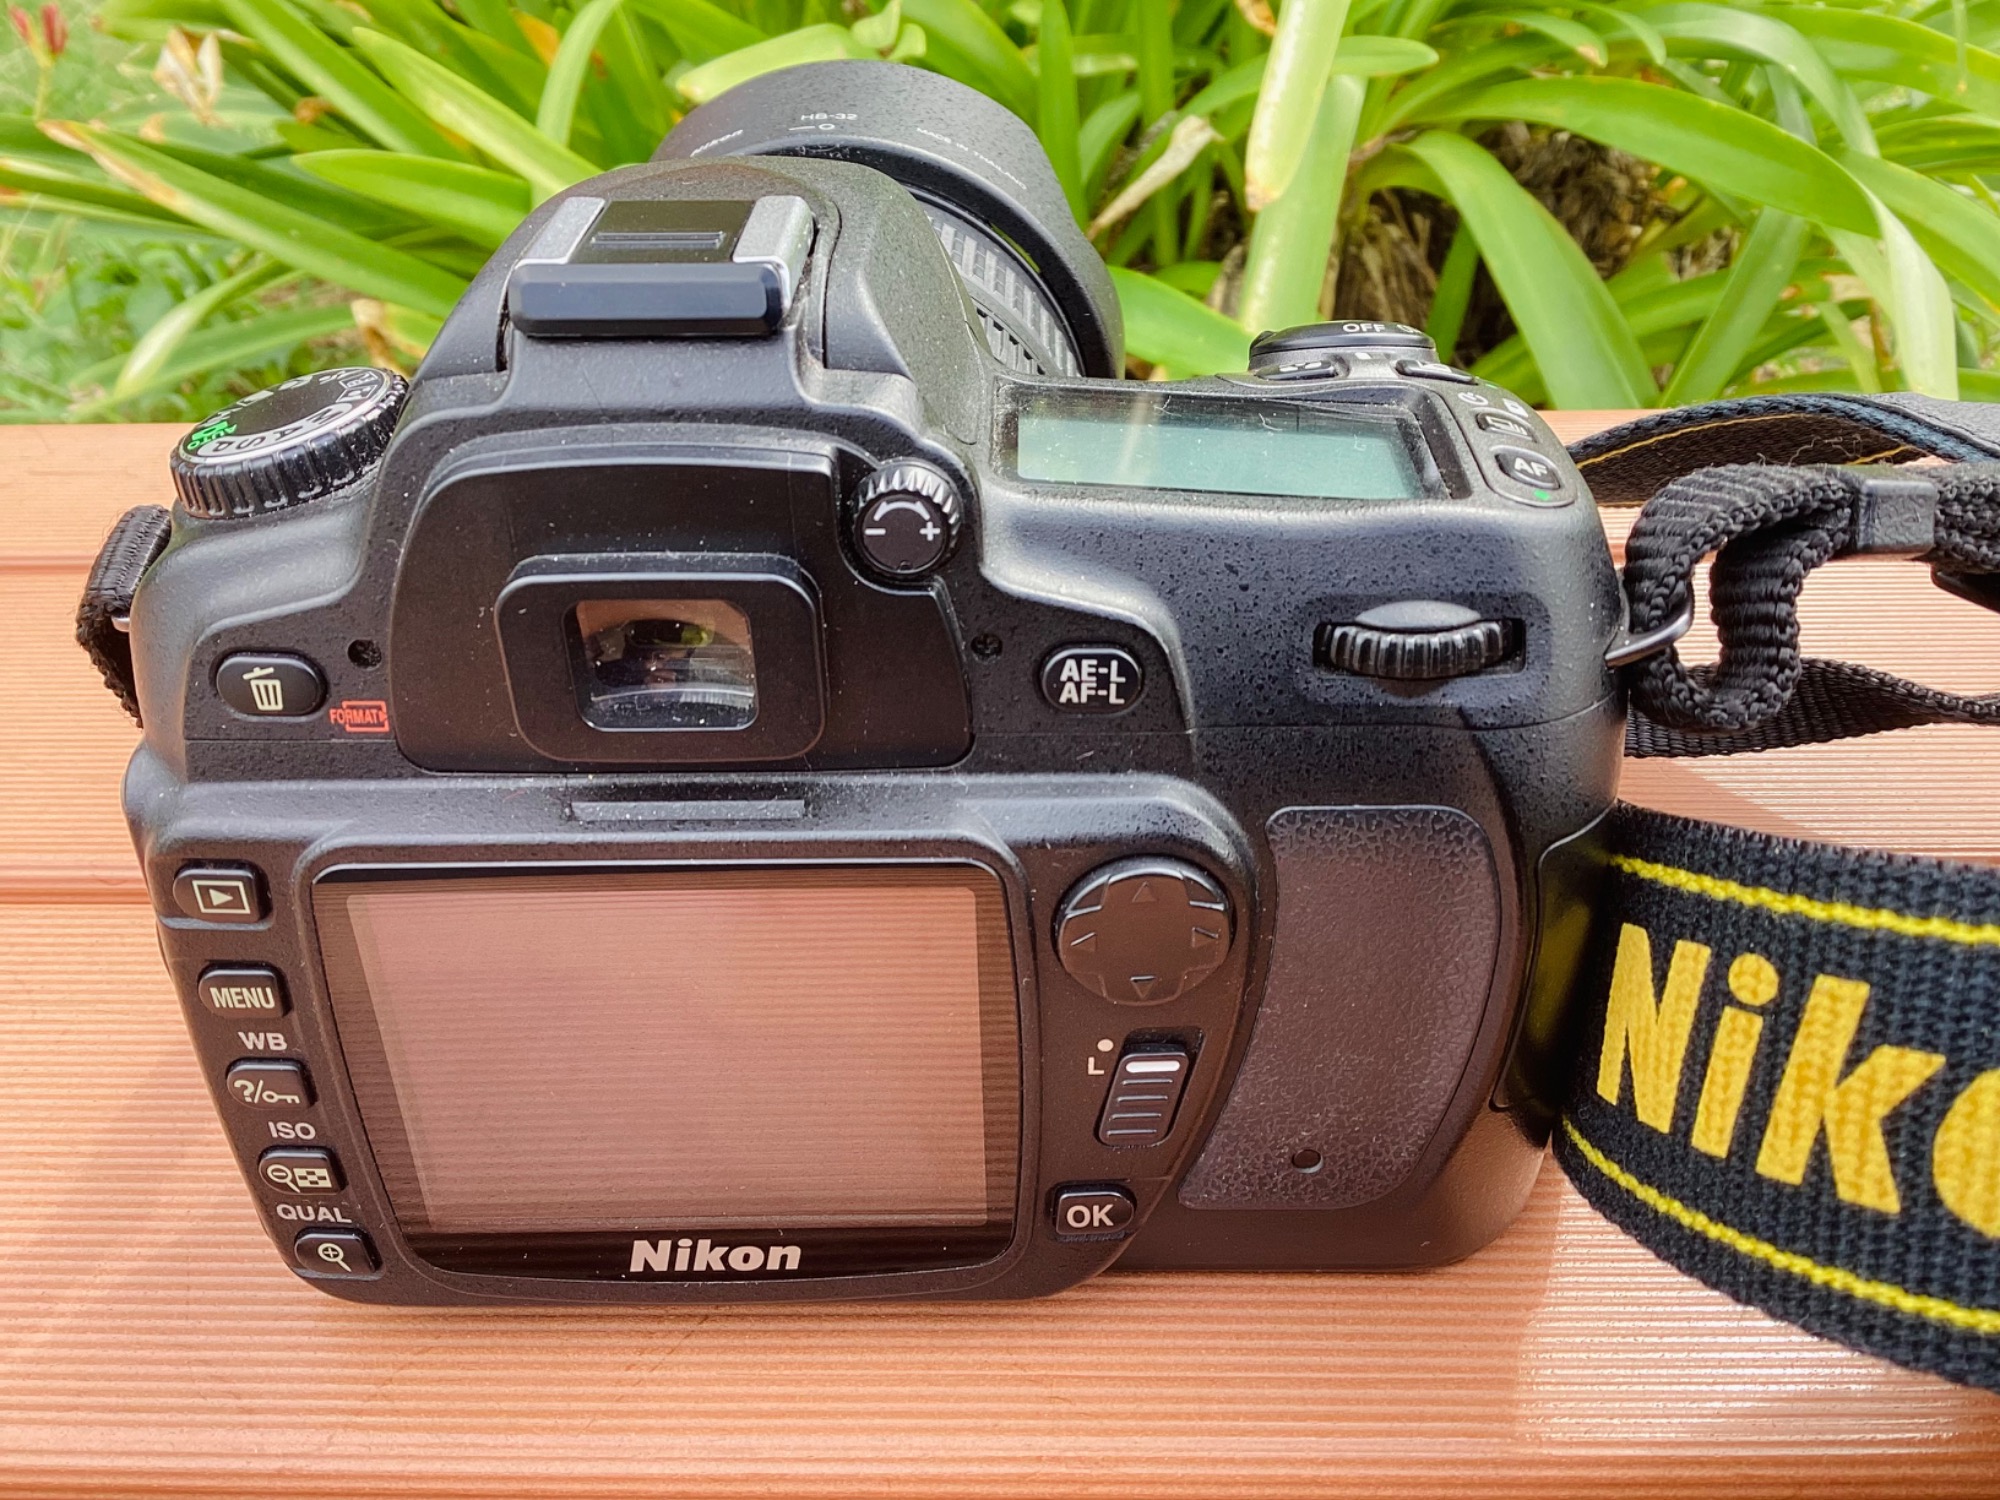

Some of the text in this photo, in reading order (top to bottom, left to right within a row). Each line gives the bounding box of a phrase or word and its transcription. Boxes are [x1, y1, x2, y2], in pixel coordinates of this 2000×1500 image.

[1342, 323, 1386, 333] OFF
[1514, 457, 1548, 477] AF
[1059, 658, 1127, 684] AE-L
[1058, 681, 1126, 705] AF-L
[329, 708, 382, 725] FORMAT
[209, 987, 276, 1009] MENU
[238, 1031, 288, 1051] WB
[1087, 1056, 1105, 1076] L
[267, 1120, 317, 1141] ISO
[276, 1203, 353, 1224] QUAL
[1066, 1203, 1115, 1229] OK
[629, 1237, 802, 1273] Nikon
